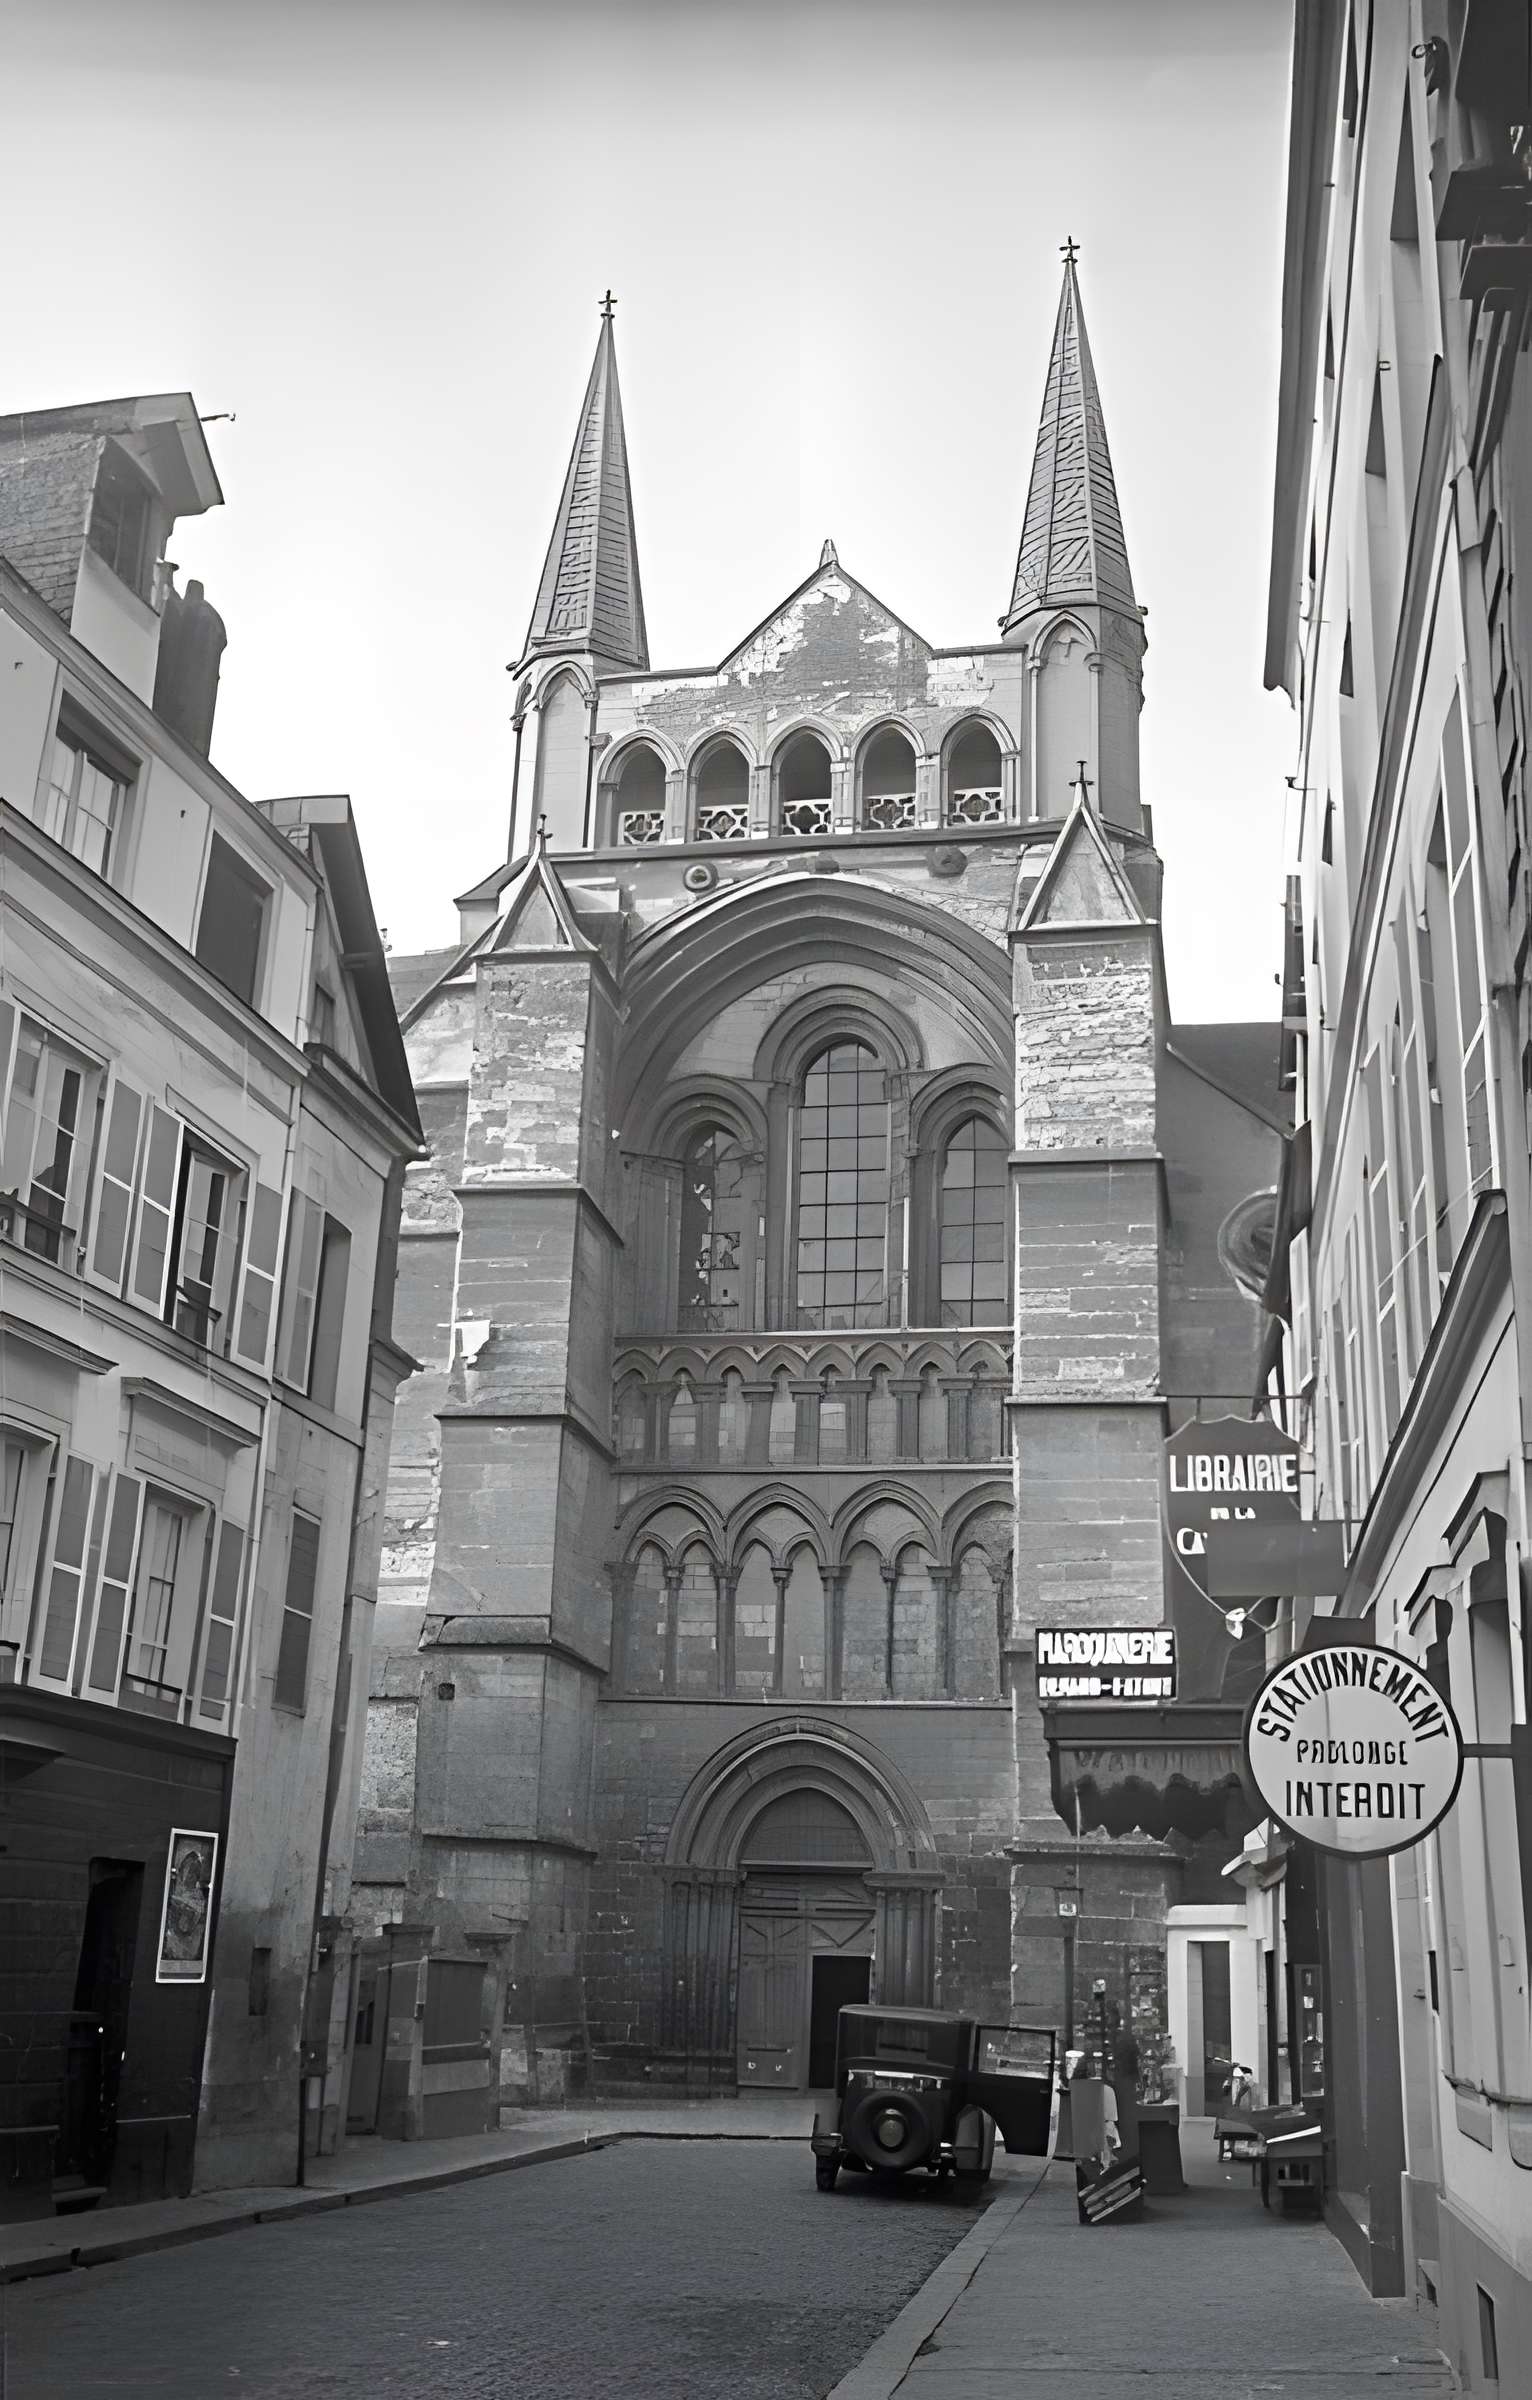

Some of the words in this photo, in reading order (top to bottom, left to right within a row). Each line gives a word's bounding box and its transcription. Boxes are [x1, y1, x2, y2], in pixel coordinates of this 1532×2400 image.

[1169, 1454, 1298, 1492] LIBRAIRIE
[1257, 1652, 1449, 1742] STATIONNEMENT
[1286, 1780, 1426, 1819] INTERDIT
